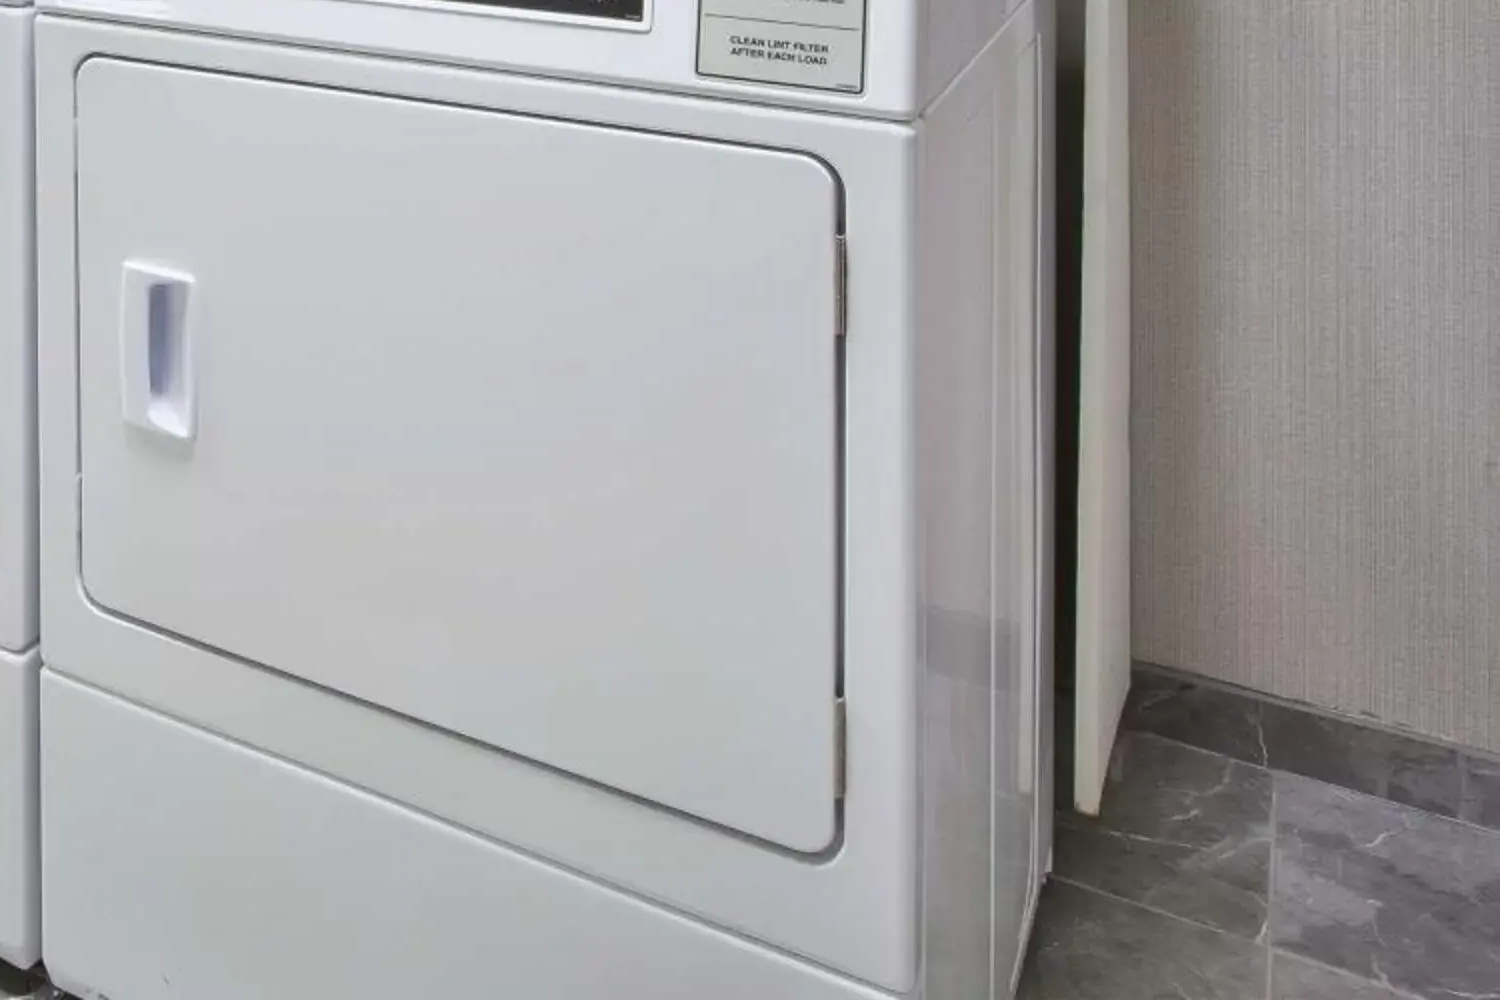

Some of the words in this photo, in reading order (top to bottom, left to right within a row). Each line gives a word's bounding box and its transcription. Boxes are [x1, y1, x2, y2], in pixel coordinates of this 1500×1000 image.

[729, 35, 765, 47] CLEAN
[767, 39, 792, 50] LINT
[793, 42, 829, 53] FILTER
[730, 47, 765, 58] AFTER
[767, 51, 795, 62] EACH
[798, 55, 827, 66] LOAD
